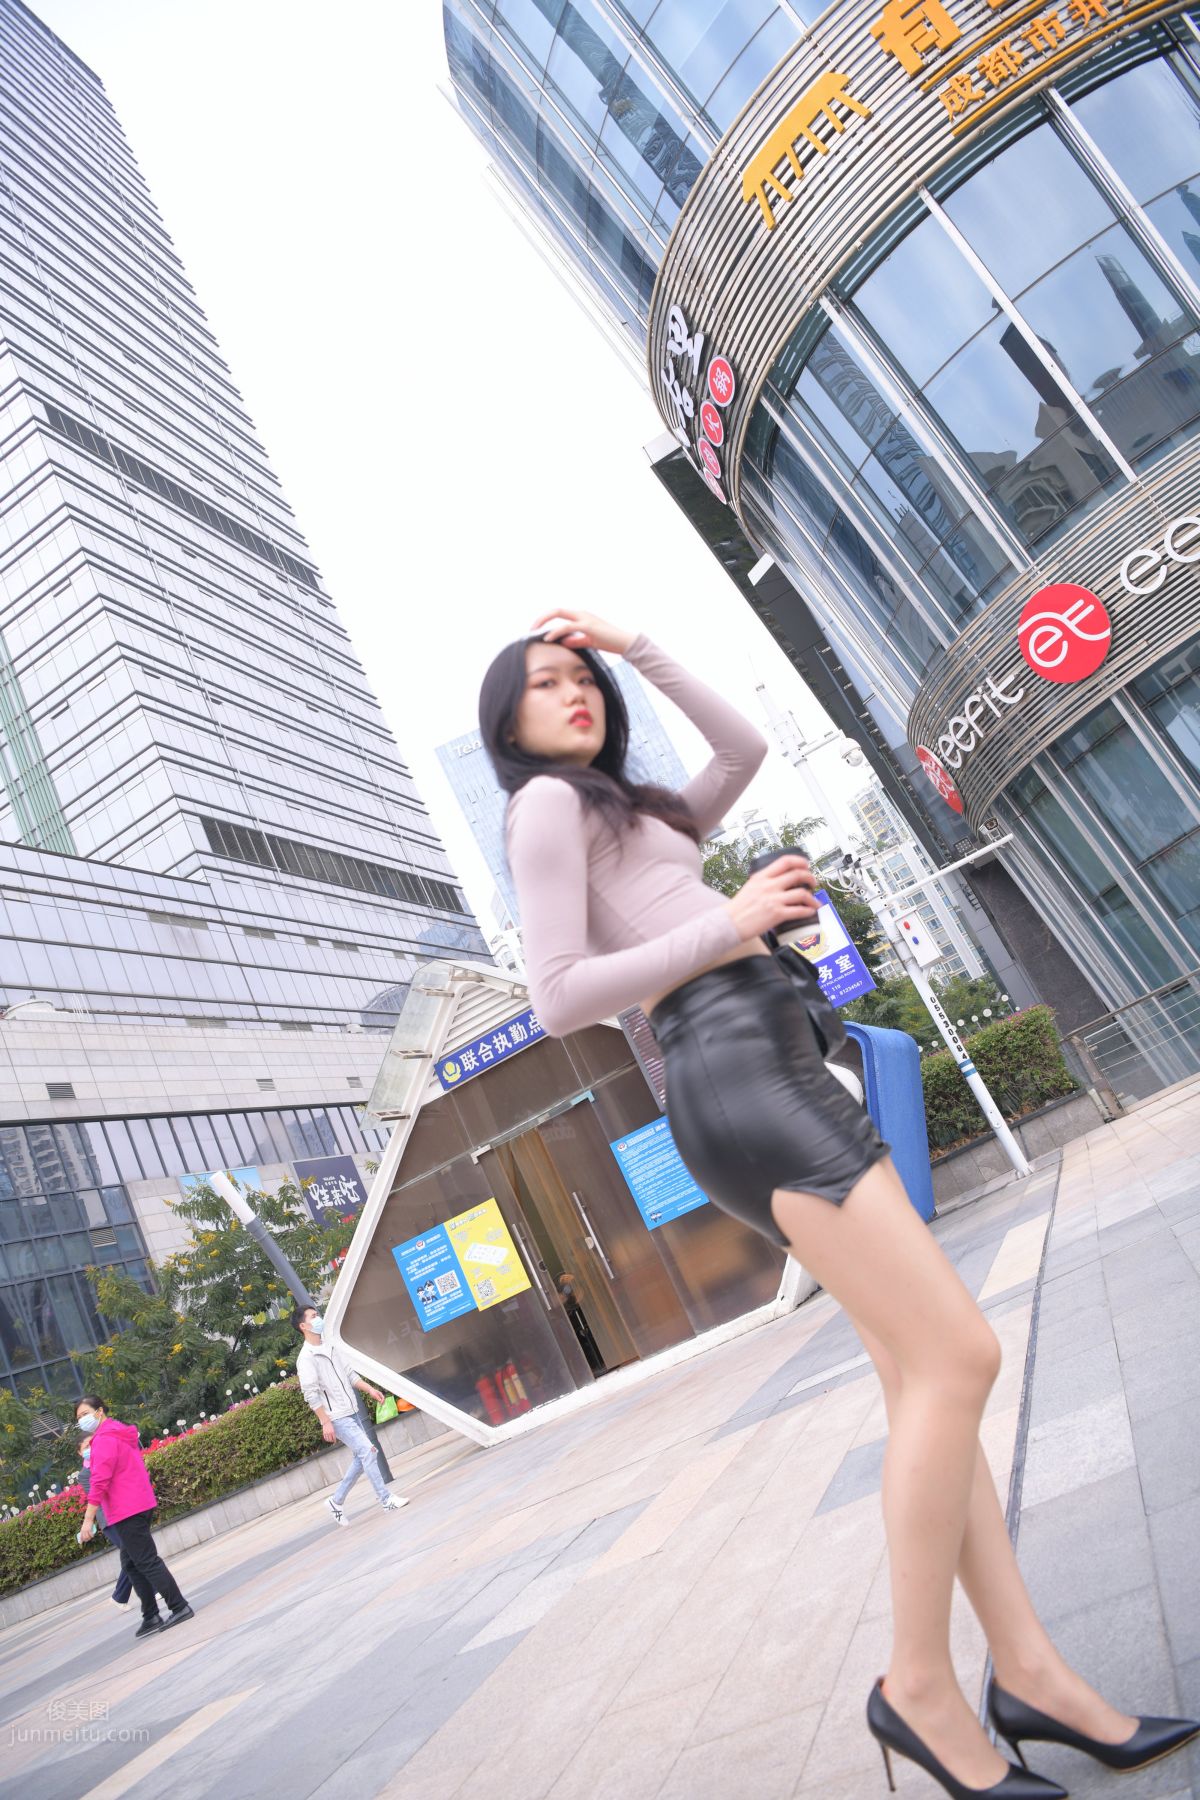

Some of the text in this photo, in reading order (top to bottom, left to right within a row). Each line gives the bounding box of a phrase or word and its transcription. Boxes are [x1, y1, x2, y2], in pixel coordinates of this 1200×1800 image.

[938, 0, 1131, 122] 成都市井
[459, 1013, 542, 1072] 联合执勤点
[929, 996, 968, 1060] 05530084
